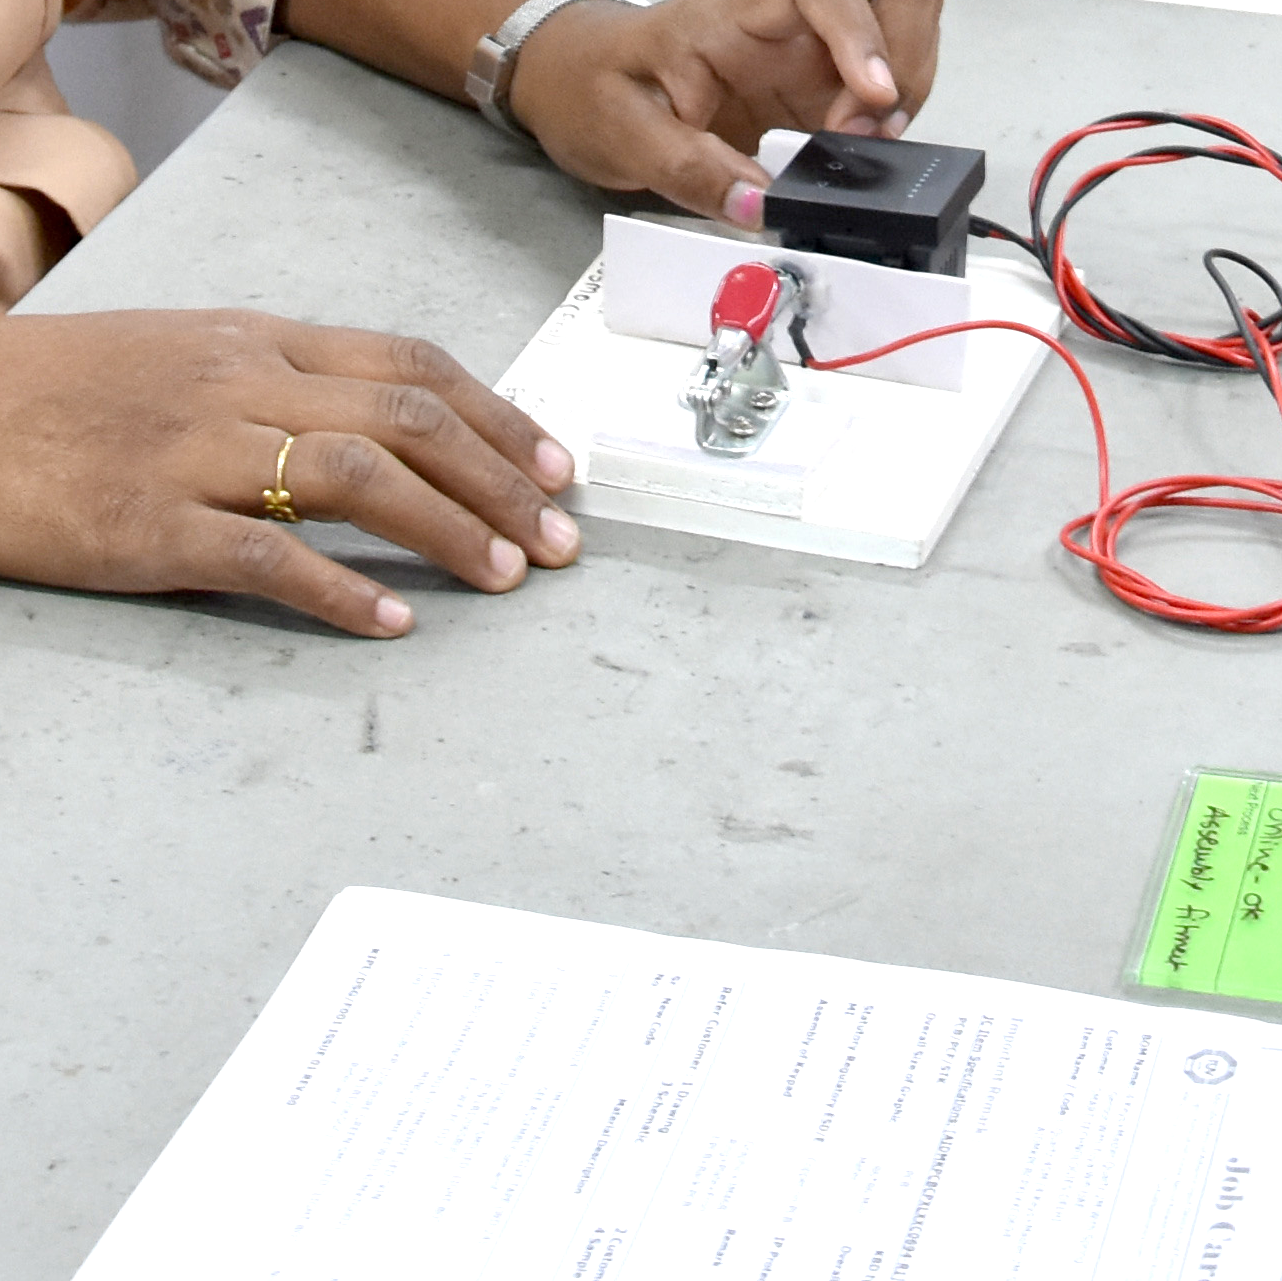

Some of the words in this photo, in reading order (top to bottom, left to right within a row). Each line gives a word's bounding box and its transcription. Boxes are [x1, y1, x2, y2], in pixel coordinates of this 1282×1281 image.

[1250, 783, 1262, 800] Next
[1237, 803, 1257, 834] Process
[655, 998, 672, 1018] New
[713, 987, 732, 1015] Refer
[644, 1022, 661, 1045] Code
[802, 999, 828, 1045] Assembly
[917, 1013, 936, 1047] Overall
[980, 1015, 994, 1025] JC
[690, 1020, 719, 1070] Customer
[972, 1029, 990, 1052] Item
[992, 1018, 1023, 1081] Important
[1080, 1028, 1094, 1049] Item
[1098, 1030, 1118, 1075] Customer
[1138, 1035, 1152, 1055] BOM
[799, 1049, 808, 1059] of
[909, 1051, 924, 1070] Size
[1071, 1054, 1086, 1080] Name
[783, 1062, 805, 1097] Keypad
[904, 1074, 914, 1083] of
[602, 1099, 627, 1137] Material
[976, 1087, 1001, 1133] Remark
[1060, 1093, 1074, 1115] Code
[574, 1140, 608, 1194] Description
[1215, 1158, 1250, 1210] Job
[713, 1229, 736, 1266] Remark
[1199, 1222, 1235, 1281] Car
